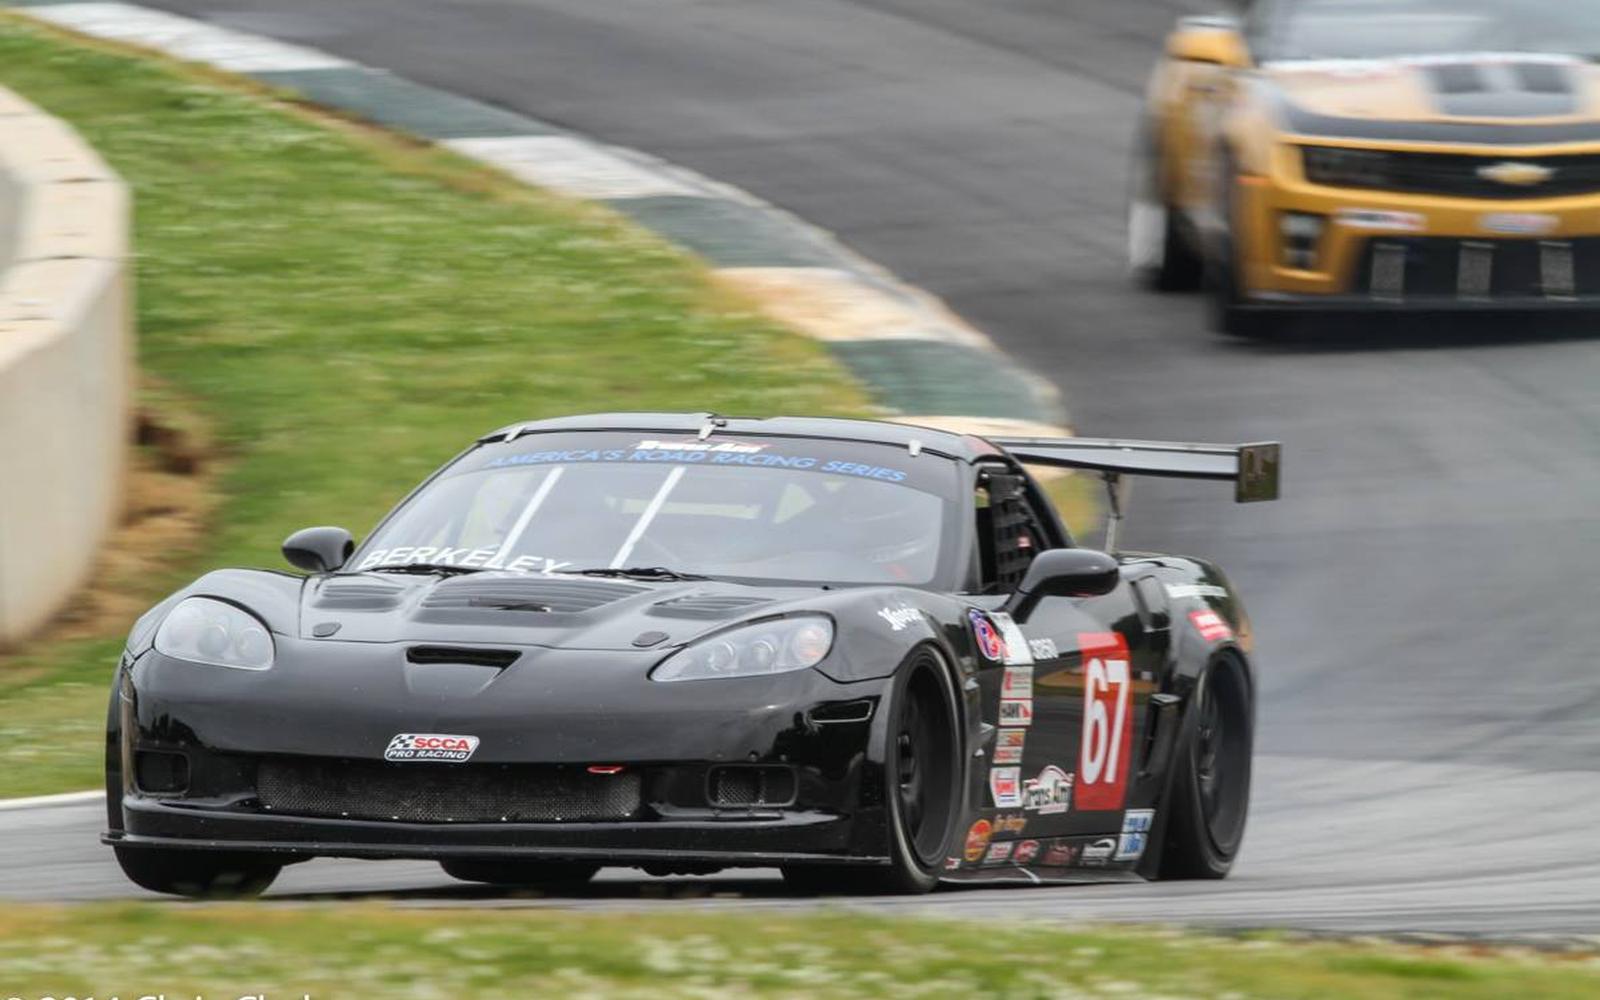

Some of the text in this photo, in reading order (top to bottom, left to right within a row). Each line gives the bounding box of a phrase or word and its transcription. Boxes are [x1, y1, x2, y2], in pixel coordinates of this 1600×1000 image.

[490, 448, 908, 482] AMERICA'S ROAD RACING SERIES
[356, 544, 572, 573] BERKELEY
[1081, 657, 1130, 785] 67
[387, 750, 467, 760] PRO RACING
[414, 737, 470, 750] SCCA
